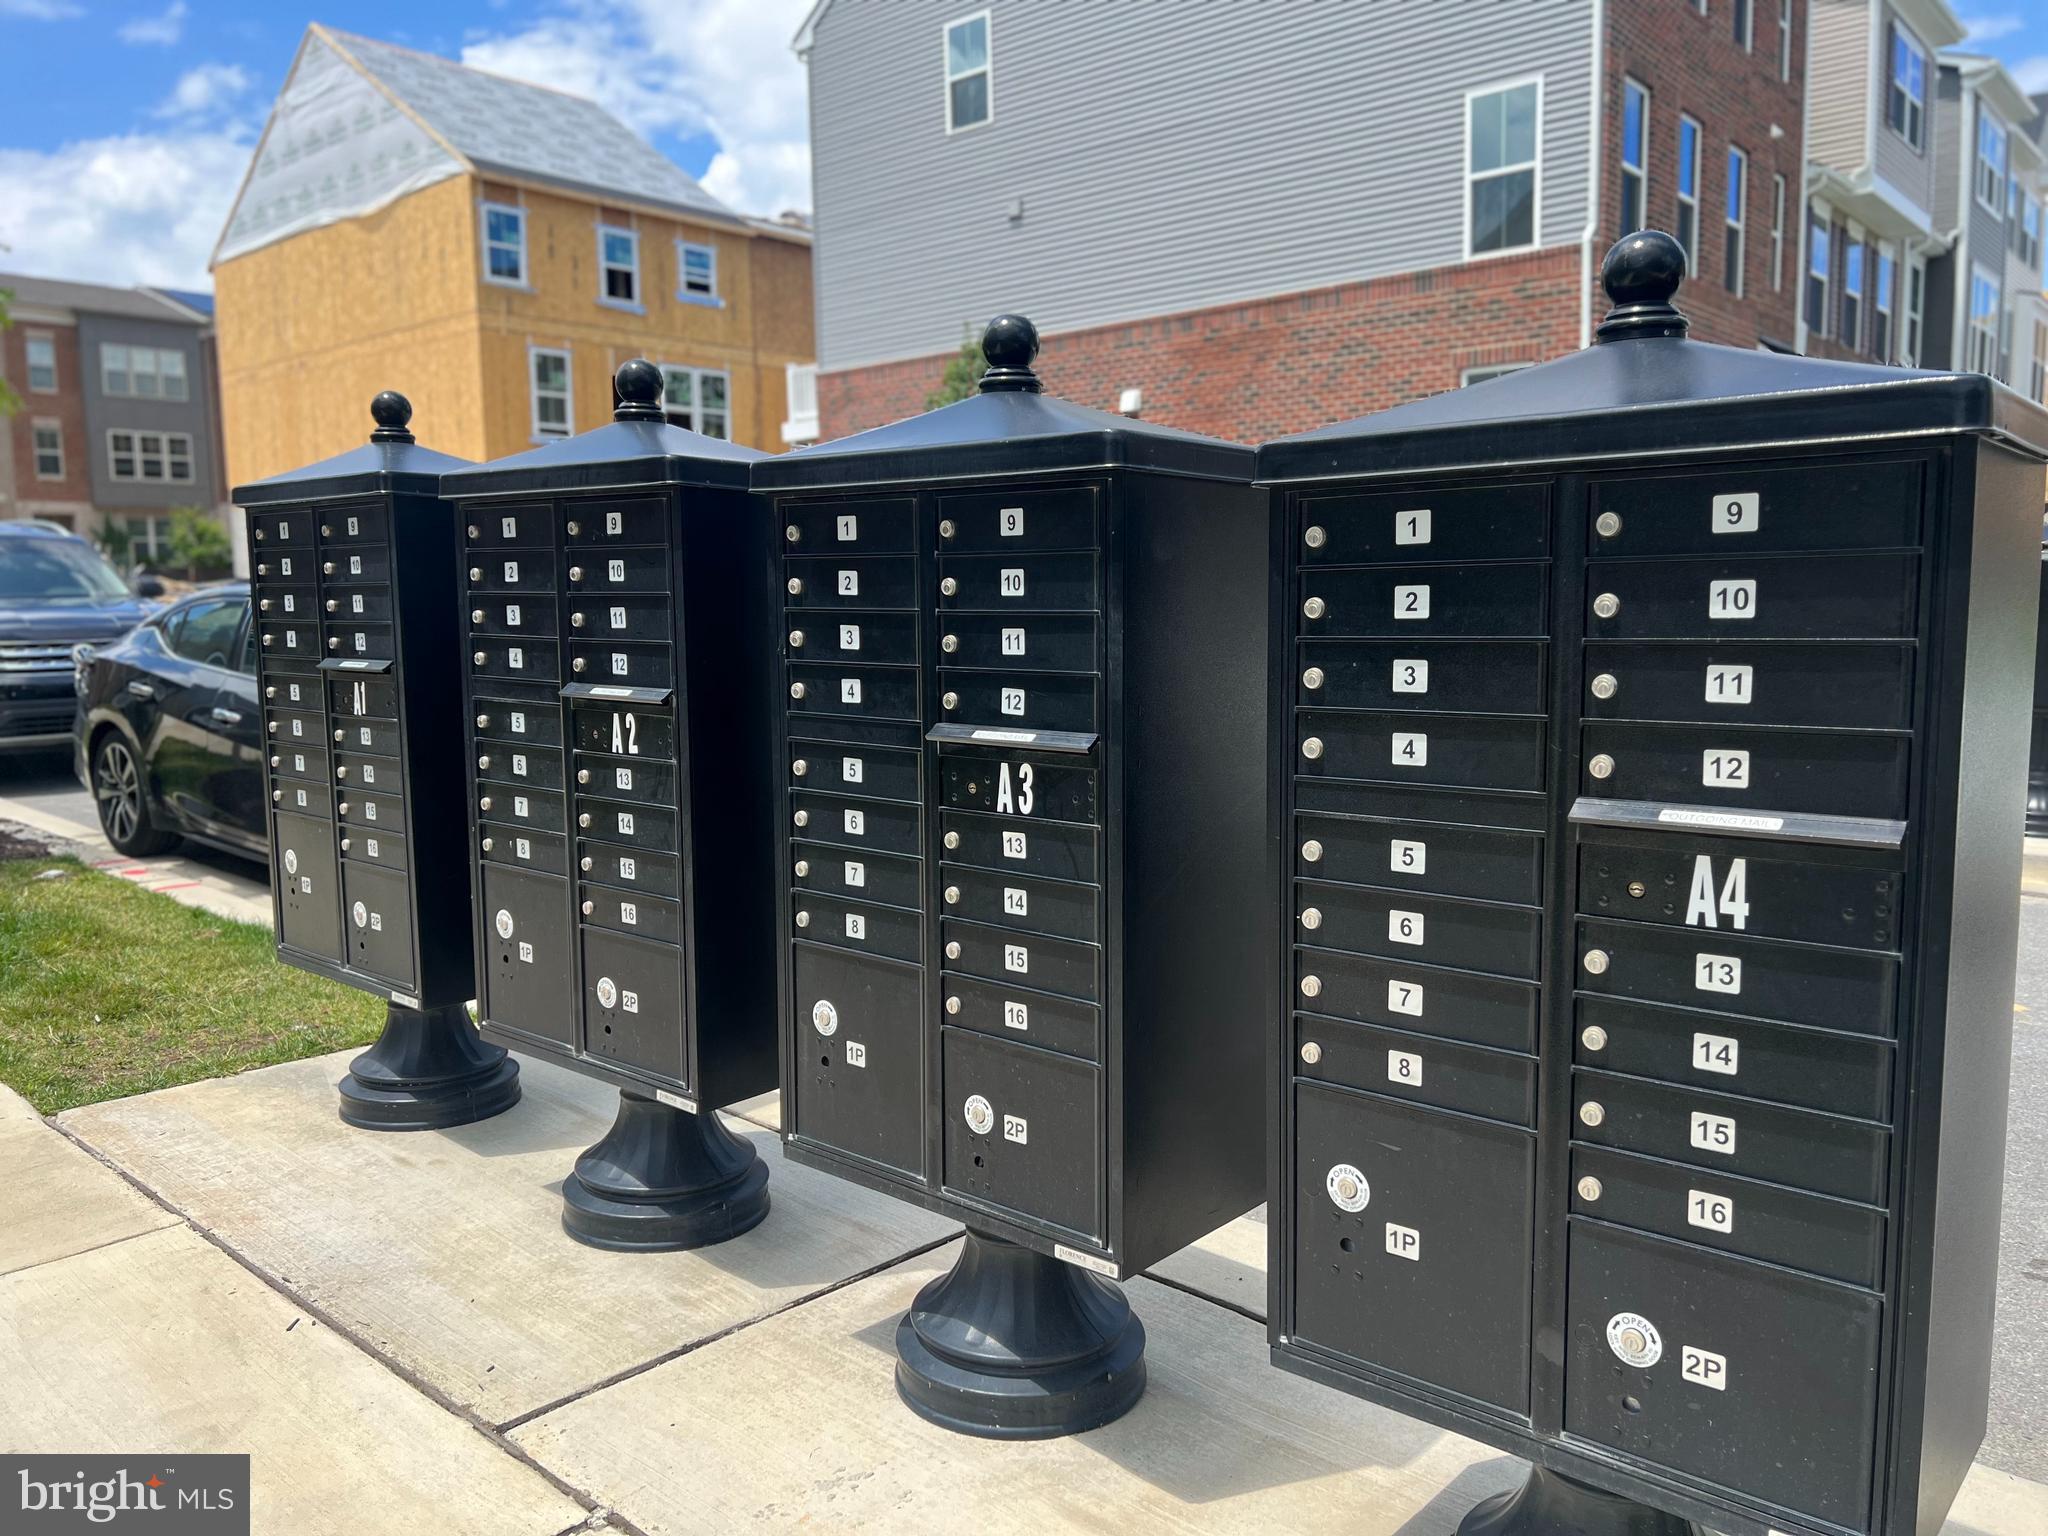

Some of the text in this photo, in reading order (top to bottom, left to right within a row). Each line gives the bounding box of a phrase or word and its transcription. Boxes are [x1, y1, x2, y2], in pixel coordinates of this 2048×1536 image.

[1726, 501, 1743, 525] 9
[507, 522, 512, 534] 1
[611, 517, 617, 531] 9
[844, 520, 849, 537] 1
[1008, 514, 1016, 532] 9
[1407, 516, 1417, 538] 1
[352, 560, 359, 571] 10
[509, 566, 514, 579] 2
[611, 565, 623, 578] 10
[845, 575, 852, 591] 2
[1005, 575, 1021, 592] 10
[354, 599, 361, 609] 11
[1404, 591, 1418, 612] 2
[1716, 587, 1750, 611] 10
[511, 610, 516, 622] 3
[613, 612, 623, 625] 11
[356, 637, 364, 648] 12
[847, 629, 854, 646] 3
[1006, 634, 1021, 651] 11
[512, 653, 518, 665] 4
[615, 658, 626, 672] 12
[1403, 665, 1416, 686] 3
[1713, 671, 1743, 696] 11
[353, 681, 366, 716] A1
[848, 683, 855, 699] 4
[1005, 694, 1022, 711] 12
[516, 717, 521, 729] 5
[362, 732, 369, 742] 13
[612, 712, 639, 754] A2
[1402, 738, 1416, 759] 4
[518, 759, 523, 771] 6
[849, 762, 857, 778] 5
[1710, 756, 1743, 780] 12
[365, 769, 372, 779] 14
[619, 773, 630, 786] 13
[996, 762, 1034, 815] A3
[367, 806, 374, 817] 15
[519, 801, 524, 813] 7
[621, 818, 632, 831] 14
[851, 815, 858, 830] 6
[1670, 811, 1768, 828] OUTGOING MAIL
[369, 843, 376, 854] 16
[521, 843, 526, 855] 8
[1007, 837, 1023, 854] 13
[1401, 846, 1415, 867] 5
[623, 862, 634, 876] 15
[851, 866, 858, 881] 7
[1685, 854, 1750, 930] A4
[1008, 894, 1025, 911] 14
[371, 915, 381, 928] 2P
[624, 908, 635, 921] 16
[852, 919, 859, 934] 8
[1399, 917, 1413, 937] 6
[522, 947, 532, 959] 1P
[1008, 951, 1025, 968] 15
[1702, 961, 1735, 986] 13
[624, 995, 637, 1009] 2P
[1399, 987, 1412, 1007] 7
[1008, 1008, 1025, 1025] 16
[849, 1047, 864, 1062] 1P
[1699, 1040, 1732, 1066] 14
[1398, 1057, 1411, 1078] 8
[1007, 1121, 1025, 1138] 2P
[1697, 1119, 1730, 1146] 15
[1333, 1167, 1355, 1177] OPEN
[1694, 1198, 1727, 1225] 16
[1389, 1230, 1416, 1252] 1P
[1621, 1316, 1651, 1333] OPEN
[1685, 1353, 1722, 1379] 2P
